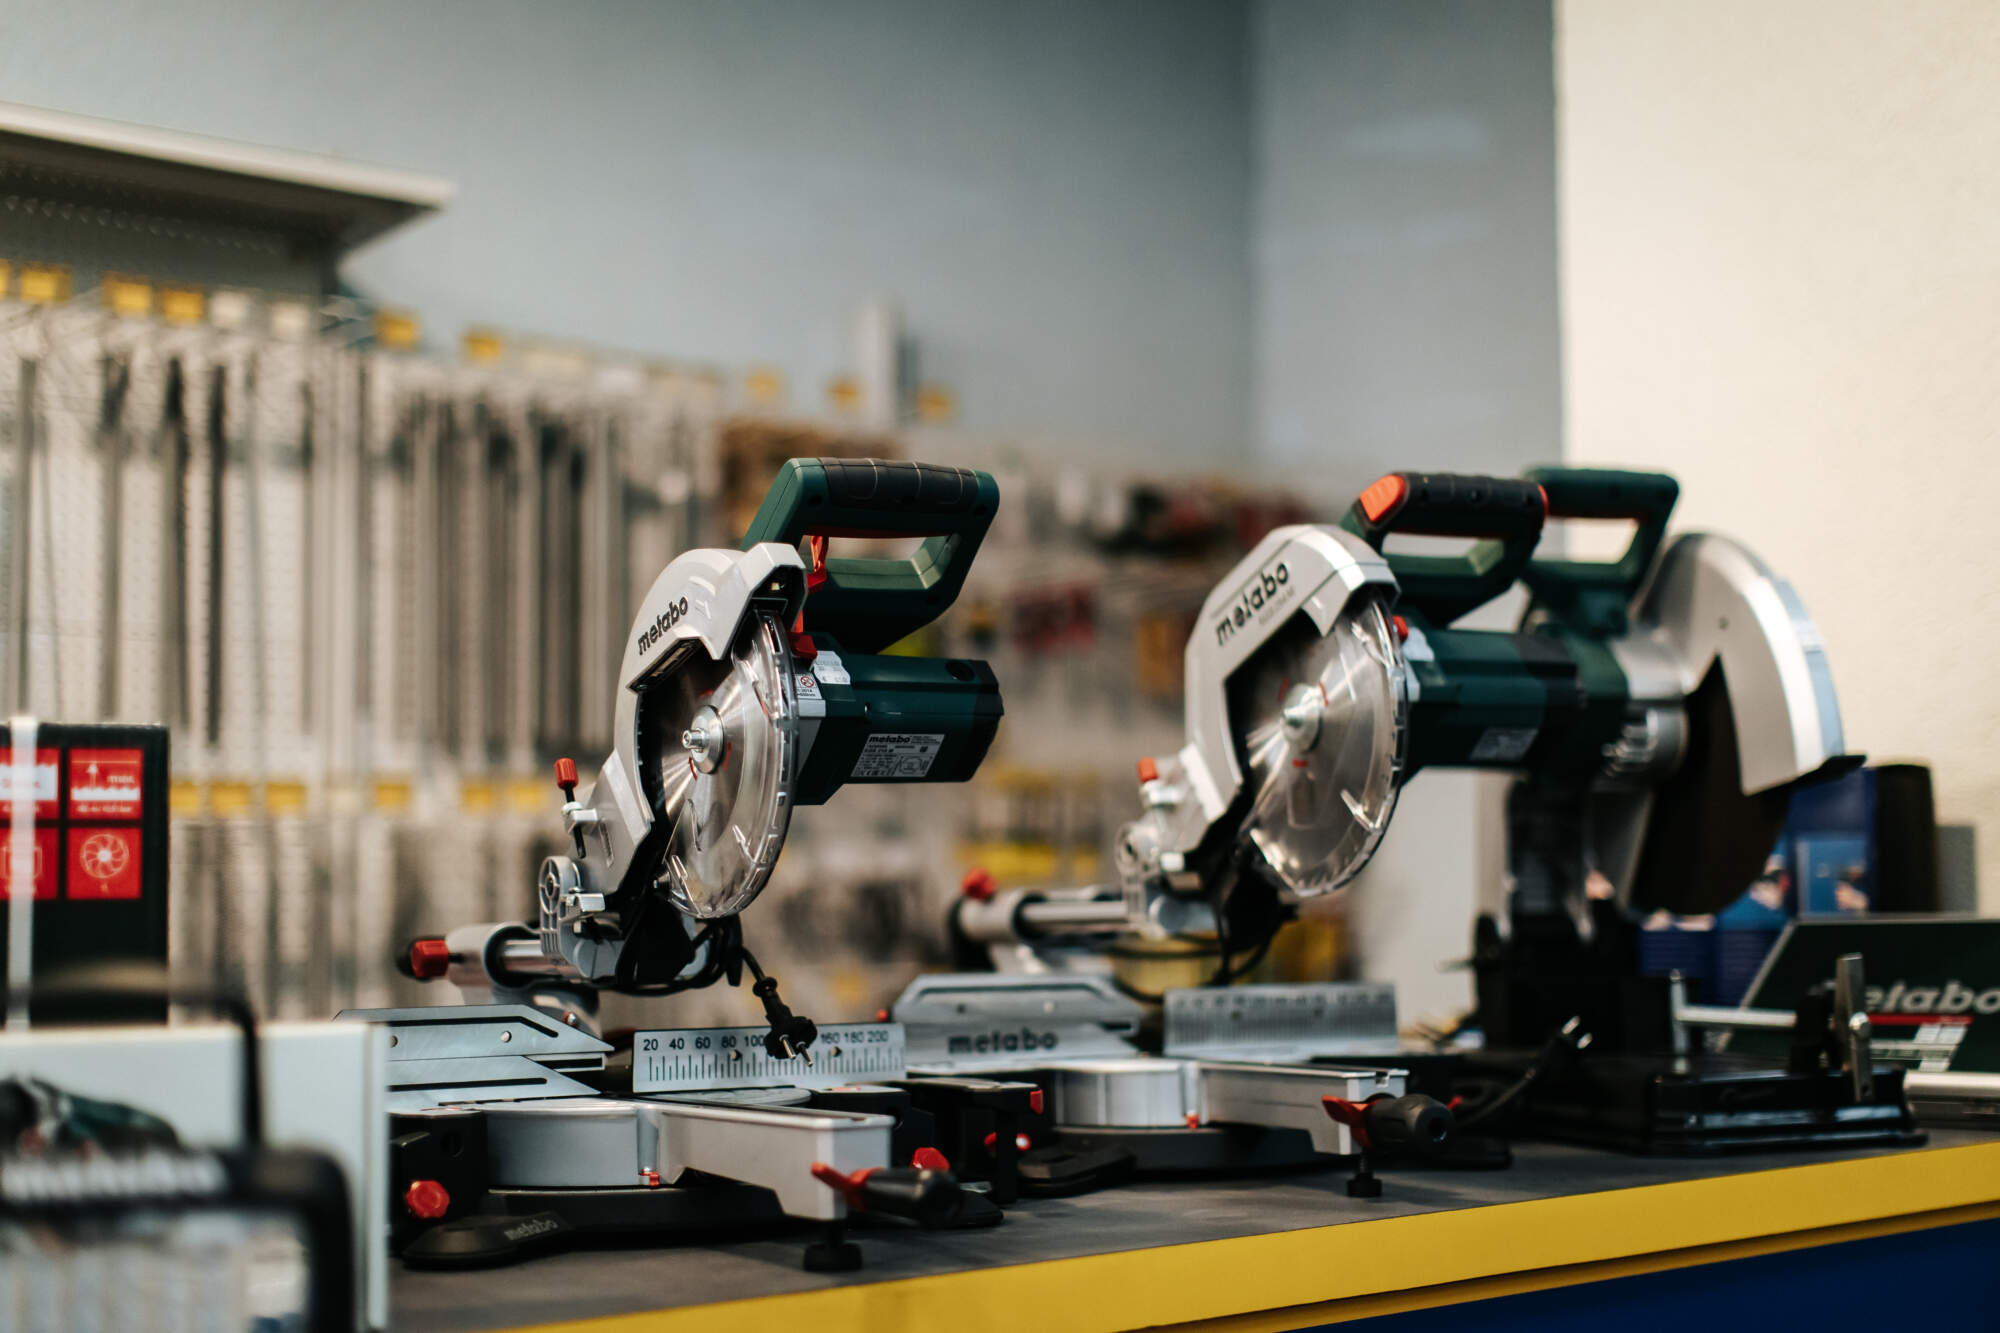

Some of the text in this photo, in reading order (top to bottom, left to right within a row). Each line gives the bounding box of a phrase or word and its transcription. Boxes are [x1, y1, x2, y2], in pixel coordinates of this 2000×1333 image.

[1216, 563, 1289, 646] metabo
[638, 596, 688, 656] metabo
[1865, 980, 2000, 1014] etabo
[643, 1038, 659, 1051] 20
[669, 1037, 685, 1050] 40
[695, 1036, 711, 1049] 60
[721, 1035, 737, 1048] 80
[744, 1034, 765, 1047] 100
[844, 1031, 865, 1043] 180
[867, 1030, 889, 1043] 200
[947, 1026, 1059, 1055] metabo
